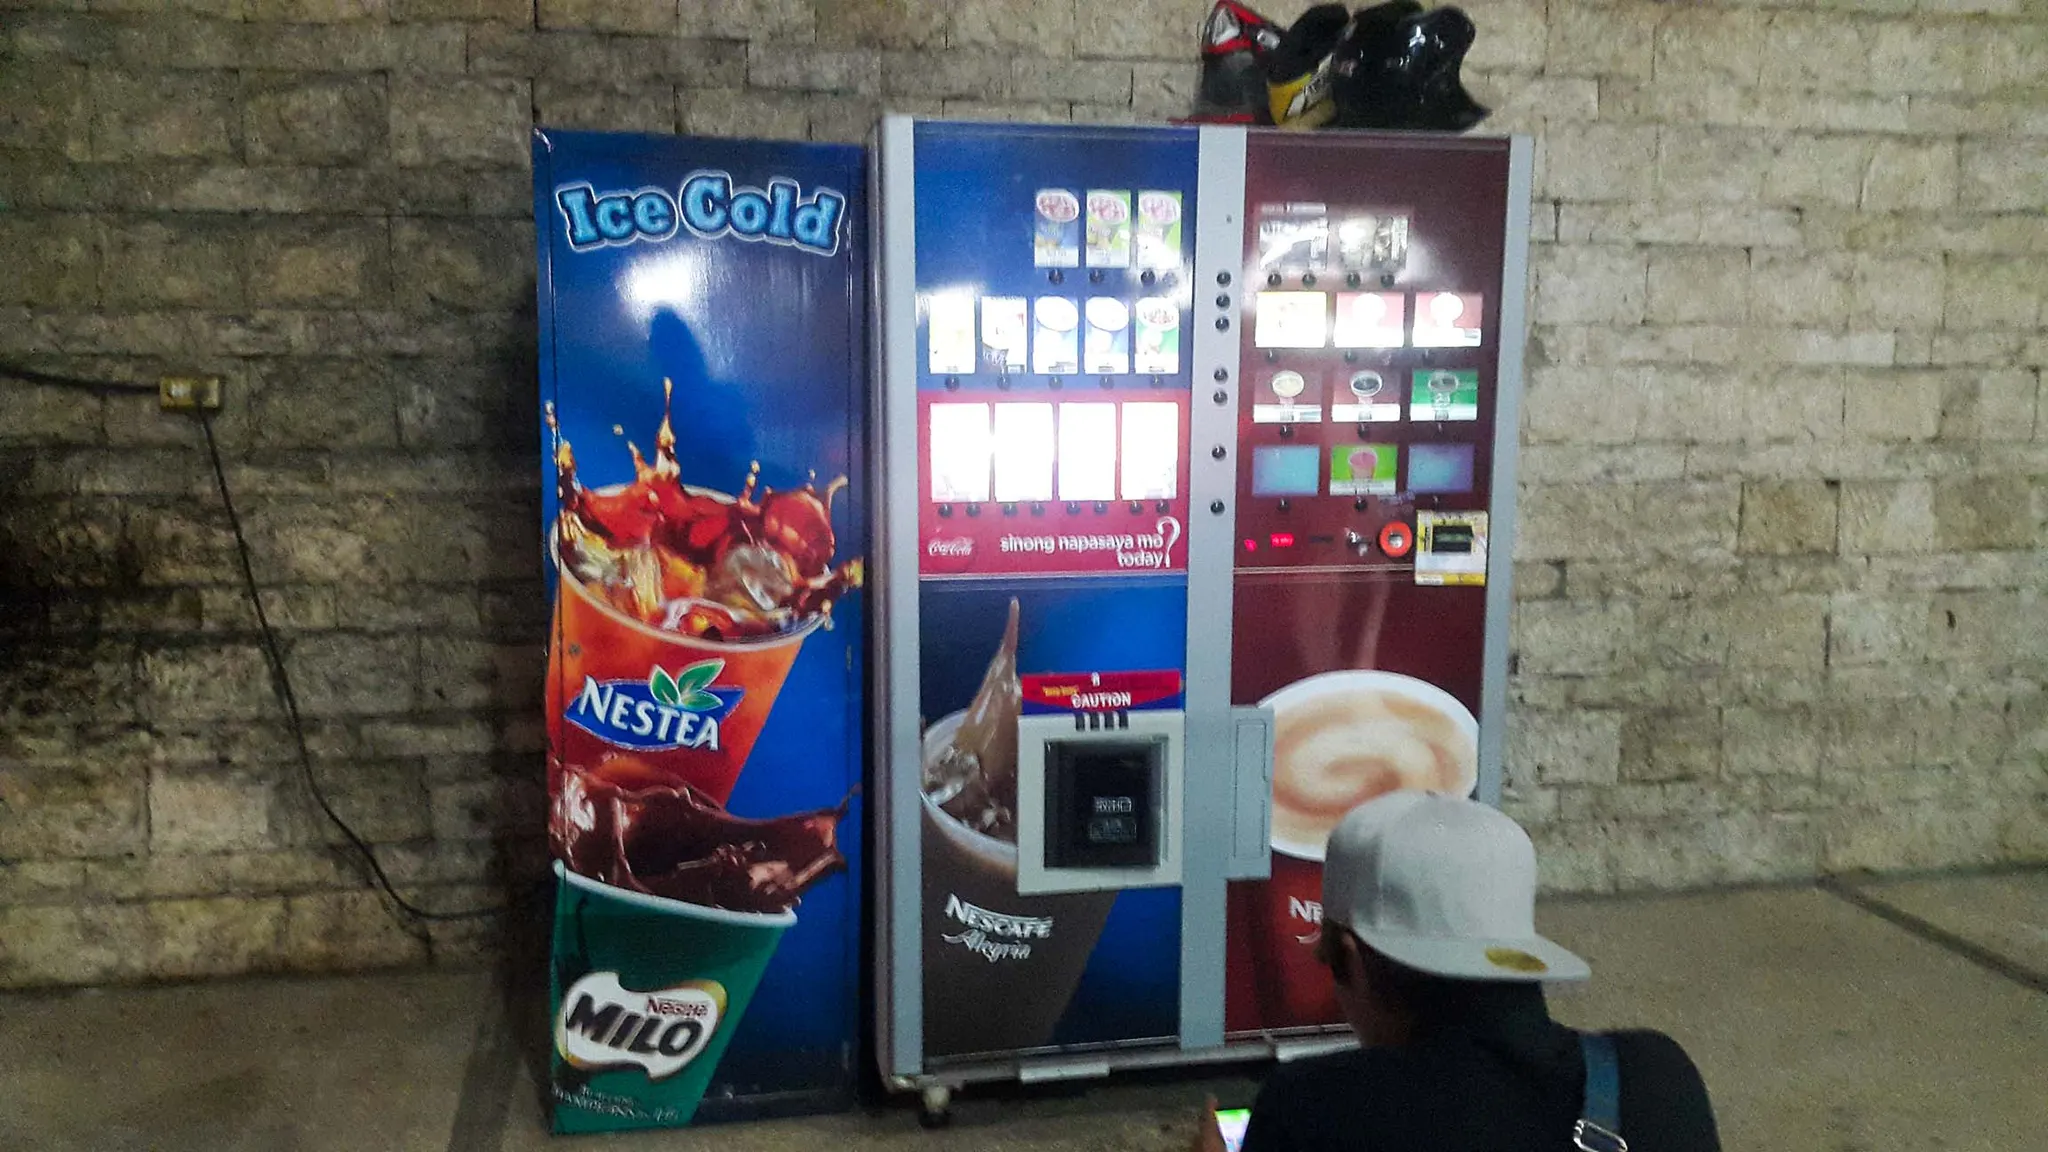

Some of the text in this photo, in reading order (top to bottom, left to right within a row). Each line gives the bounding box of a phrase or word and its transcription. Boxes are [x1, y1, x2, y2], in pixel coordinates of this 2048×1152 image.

[556, 173, 843, 253] Ice Cold
[1000, 533, 1055, 553] sinong
[1058, 534, 1134, 553] napasaya
[578, 674, 720, 752] NESTEA
[1071, 691, 1132, 709] CAUTION
[567, 992, 704, 1057] MILO
